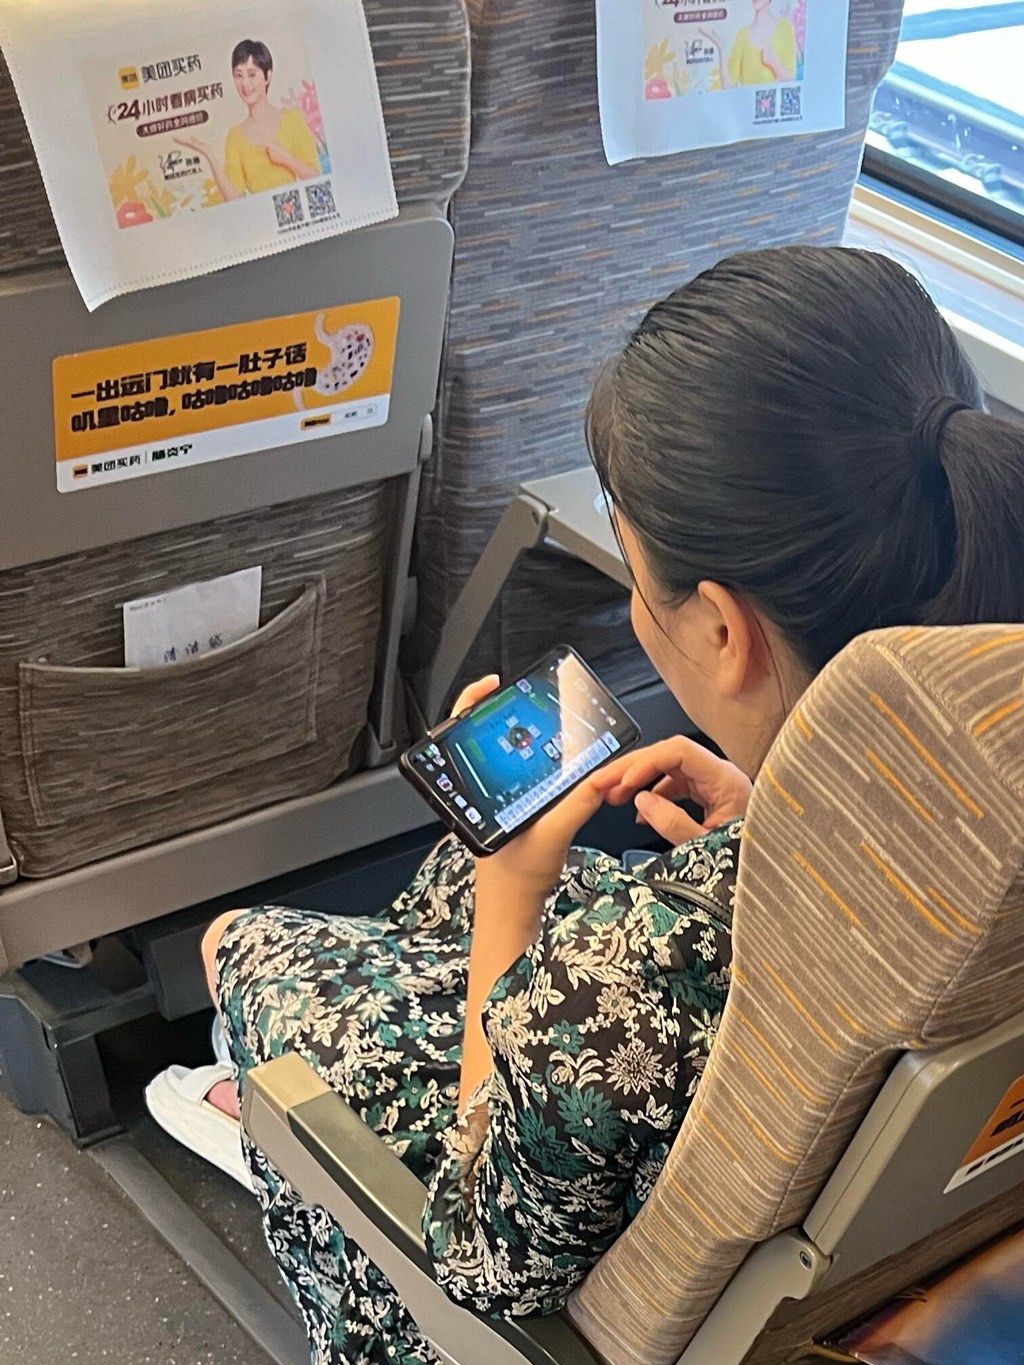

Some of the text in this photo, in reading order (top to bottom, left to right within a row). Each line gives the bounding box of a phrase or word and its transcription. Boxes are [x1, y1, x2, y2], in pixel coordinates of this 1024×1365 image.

[142, 55, 202, 83] 美团买药
[116, 82, 224, 121] 24小时看病买药
[71, 342, 308, 402] 一出远门就有一肚子话
